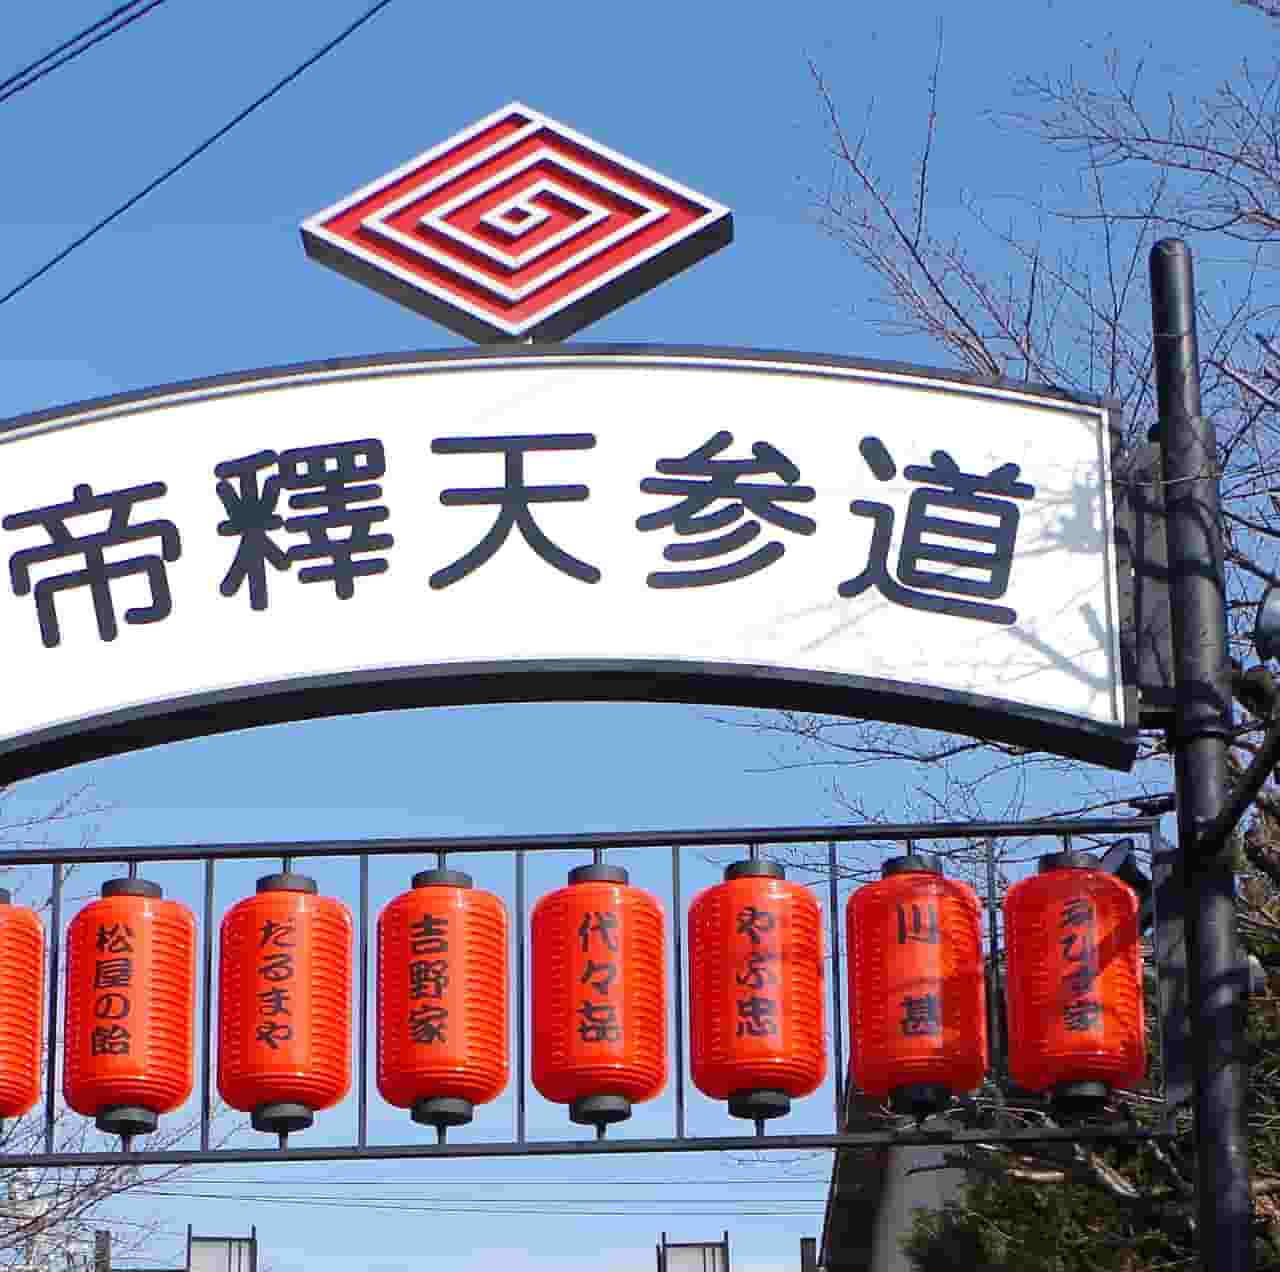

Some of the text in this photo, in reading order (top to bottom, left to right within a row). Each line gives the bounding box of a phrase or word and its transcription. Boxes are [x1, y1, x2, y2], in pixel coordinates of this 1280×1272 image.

[0, 429, 1035, 648] 帝釋天参道
[90, 922, 135, 1057] 松屋の飴
[408, 913, 449, 1044] 吉野家
